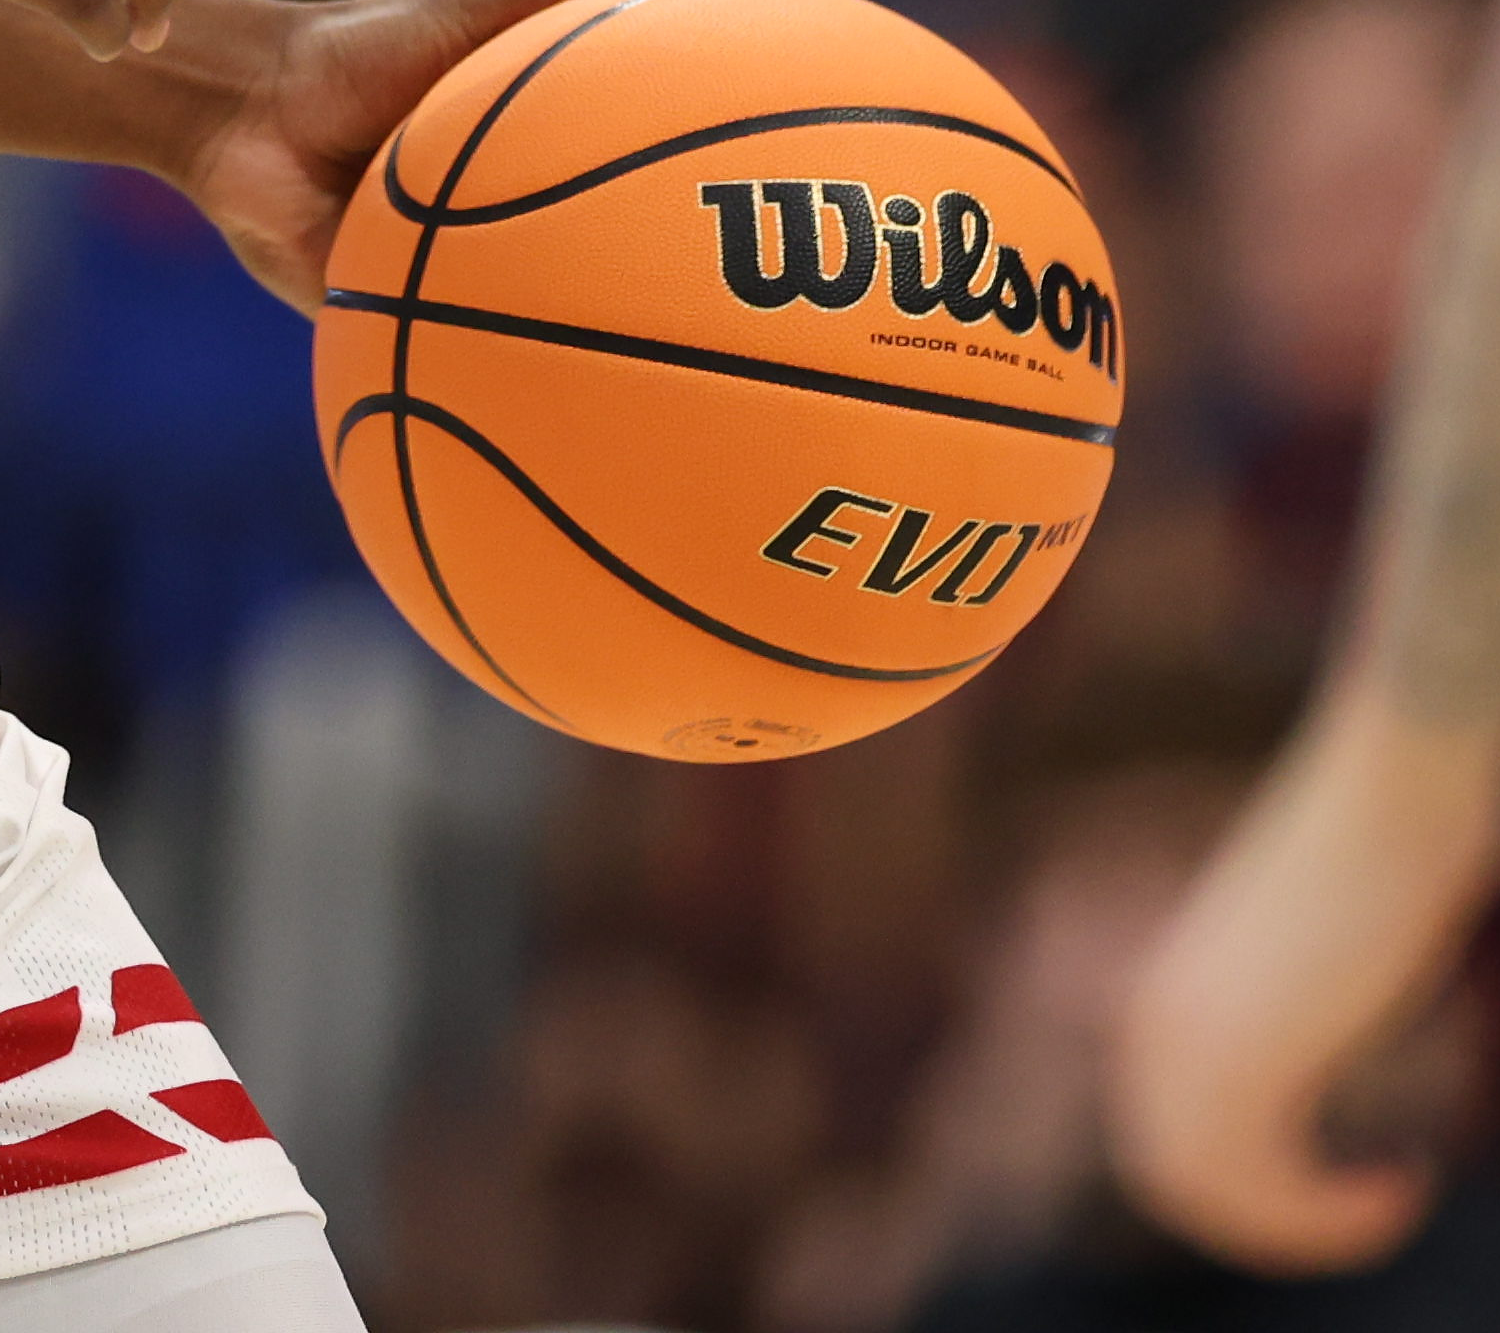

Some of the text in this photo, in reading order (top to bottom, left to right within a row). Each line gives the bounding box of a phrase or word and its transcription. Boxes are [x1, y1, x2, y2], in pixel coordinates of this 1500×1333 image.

[697, 179, 1118, 385] Wilson
[870, 333, 1065, 382] INDOOR GAME BALL
[759, 486, 1041, 607] EVO
